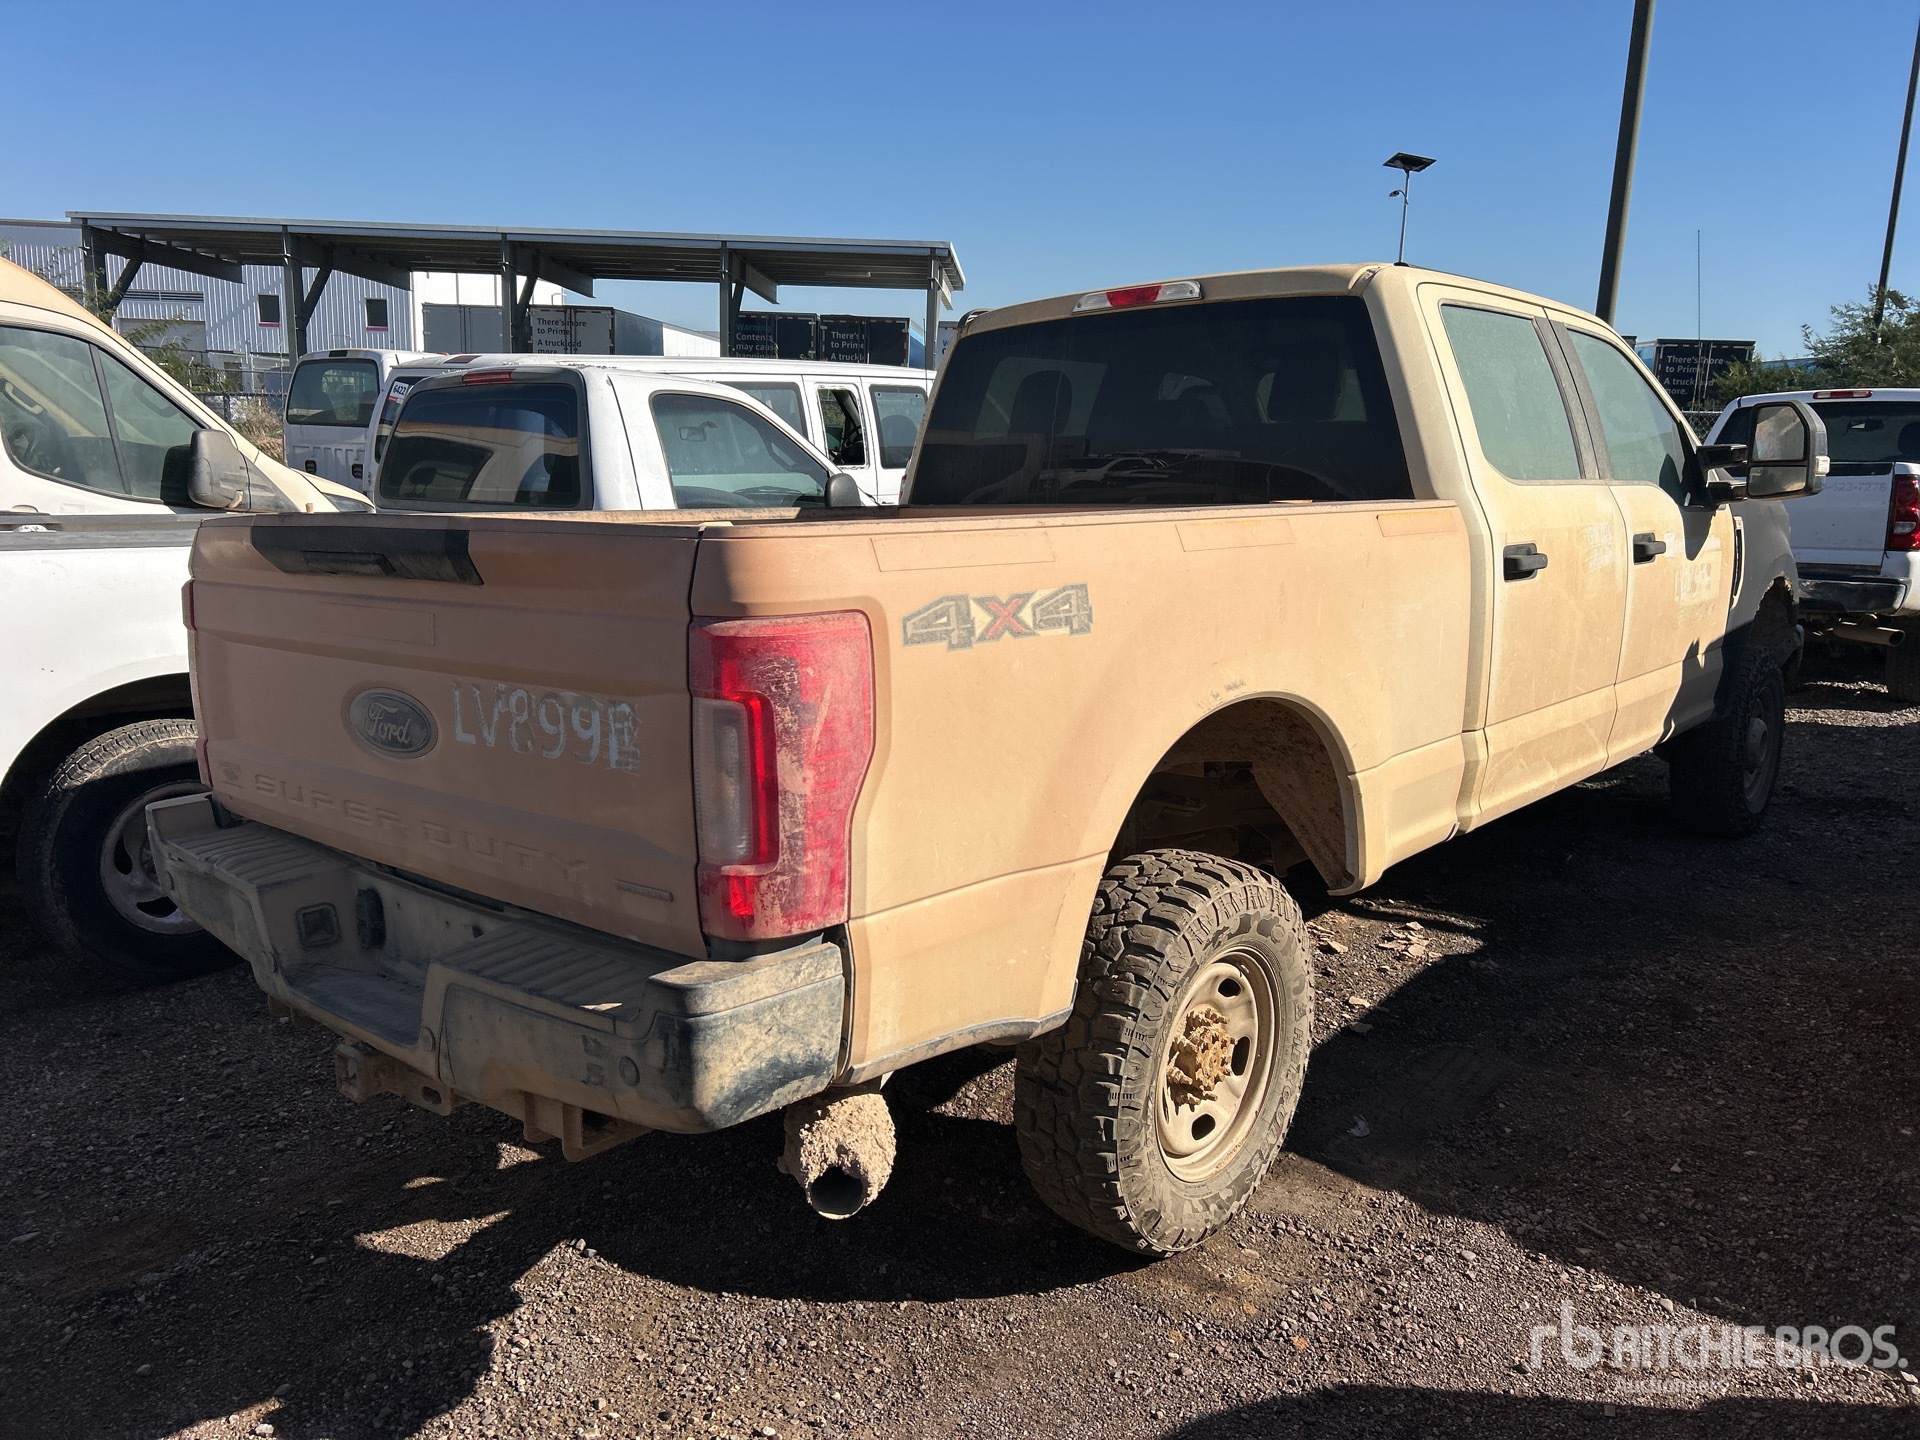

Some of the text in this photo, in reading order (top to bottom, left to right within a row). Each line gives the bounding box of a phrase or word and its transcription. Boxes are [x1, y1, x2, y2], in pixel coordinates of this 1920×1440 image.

[537, 318, 566, 326] There's
[831, 331, 860, 340] There's
[735, 344, 754, 352] may
[830, 341, 839, 349] to
[830, 353, 836, 361] A
[1667, 355, 1698, 364] There's
[1665, 365, 1675, 373] to
[1663, 377, 1671, 385] A
[254, 773, 411, 832] SUPER
